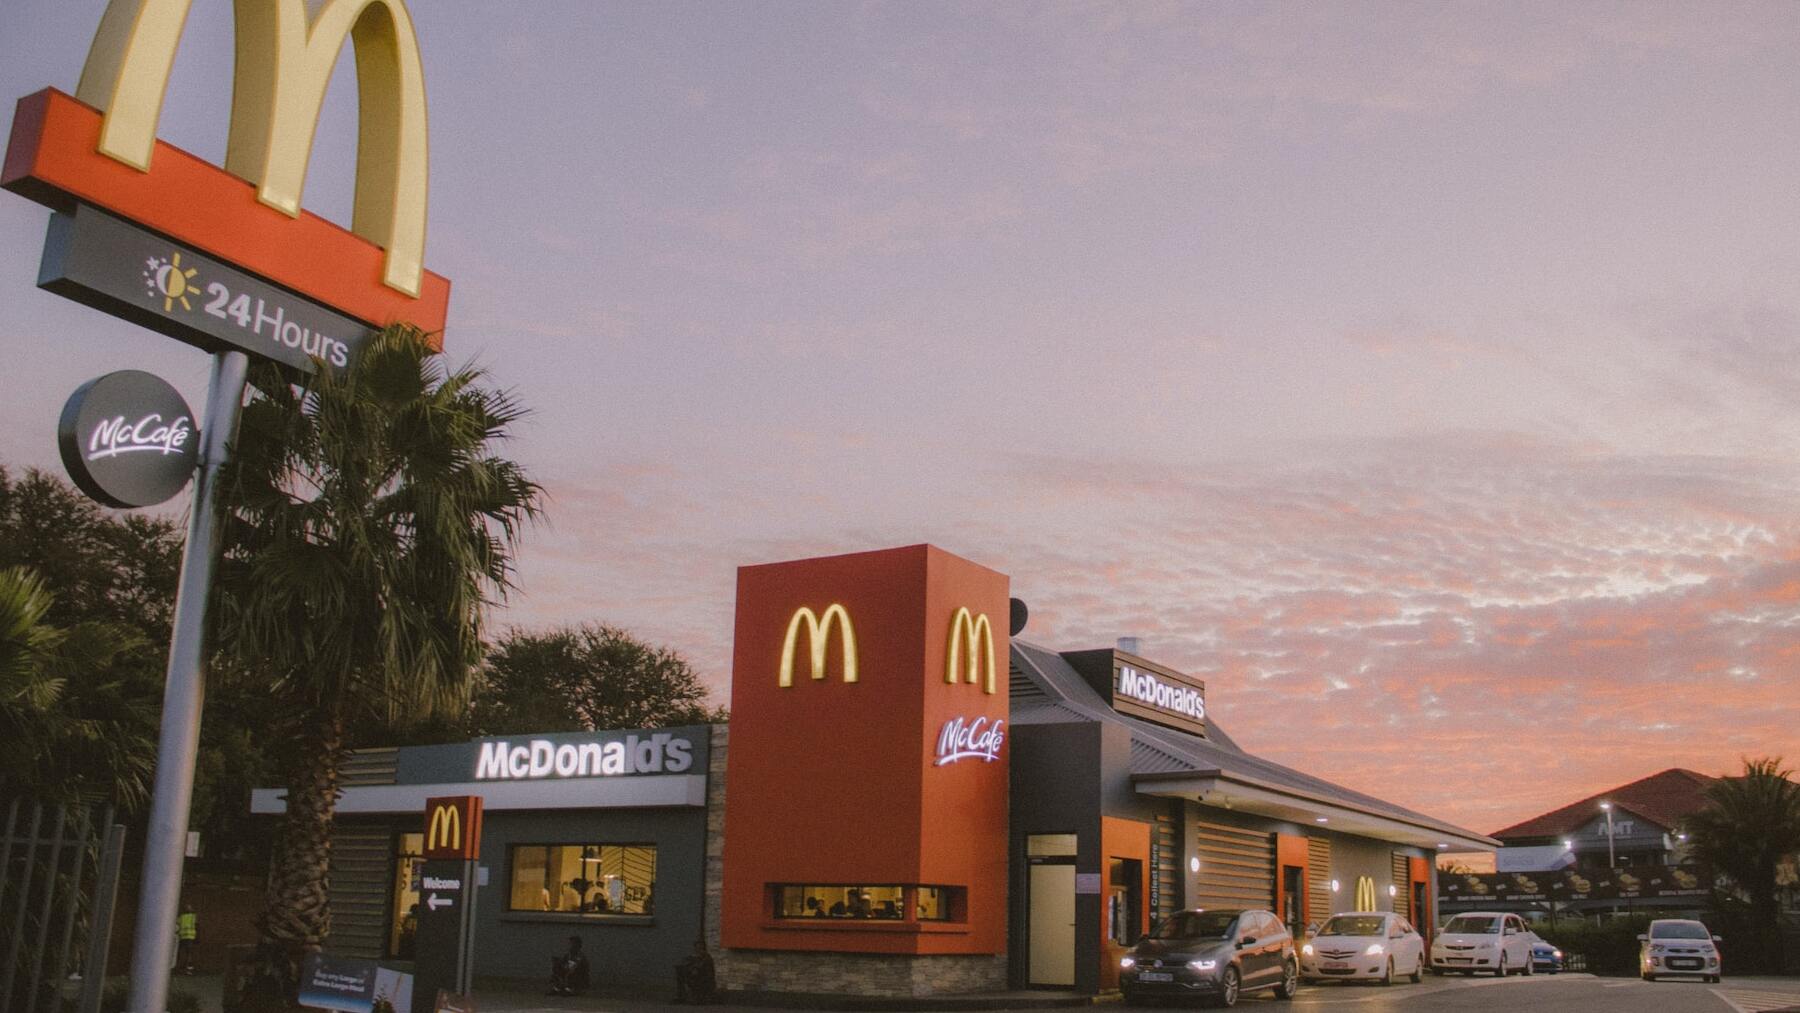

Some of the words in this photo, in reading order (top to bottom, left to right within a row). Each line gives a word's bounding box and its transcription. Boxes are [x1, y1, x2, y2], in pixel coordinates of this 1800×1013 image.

[204, 282, 251, 328] 24
[254, 299, 349, 367] Hours
[88, 414, 189, 459] McCafé
[1120, 667, 1205, 719] McDonald's
[476, 733, 693, 779] McDonald's
[935, 716, 1004, 765] McCafé
[423, 877, 460, 889] Welcome
